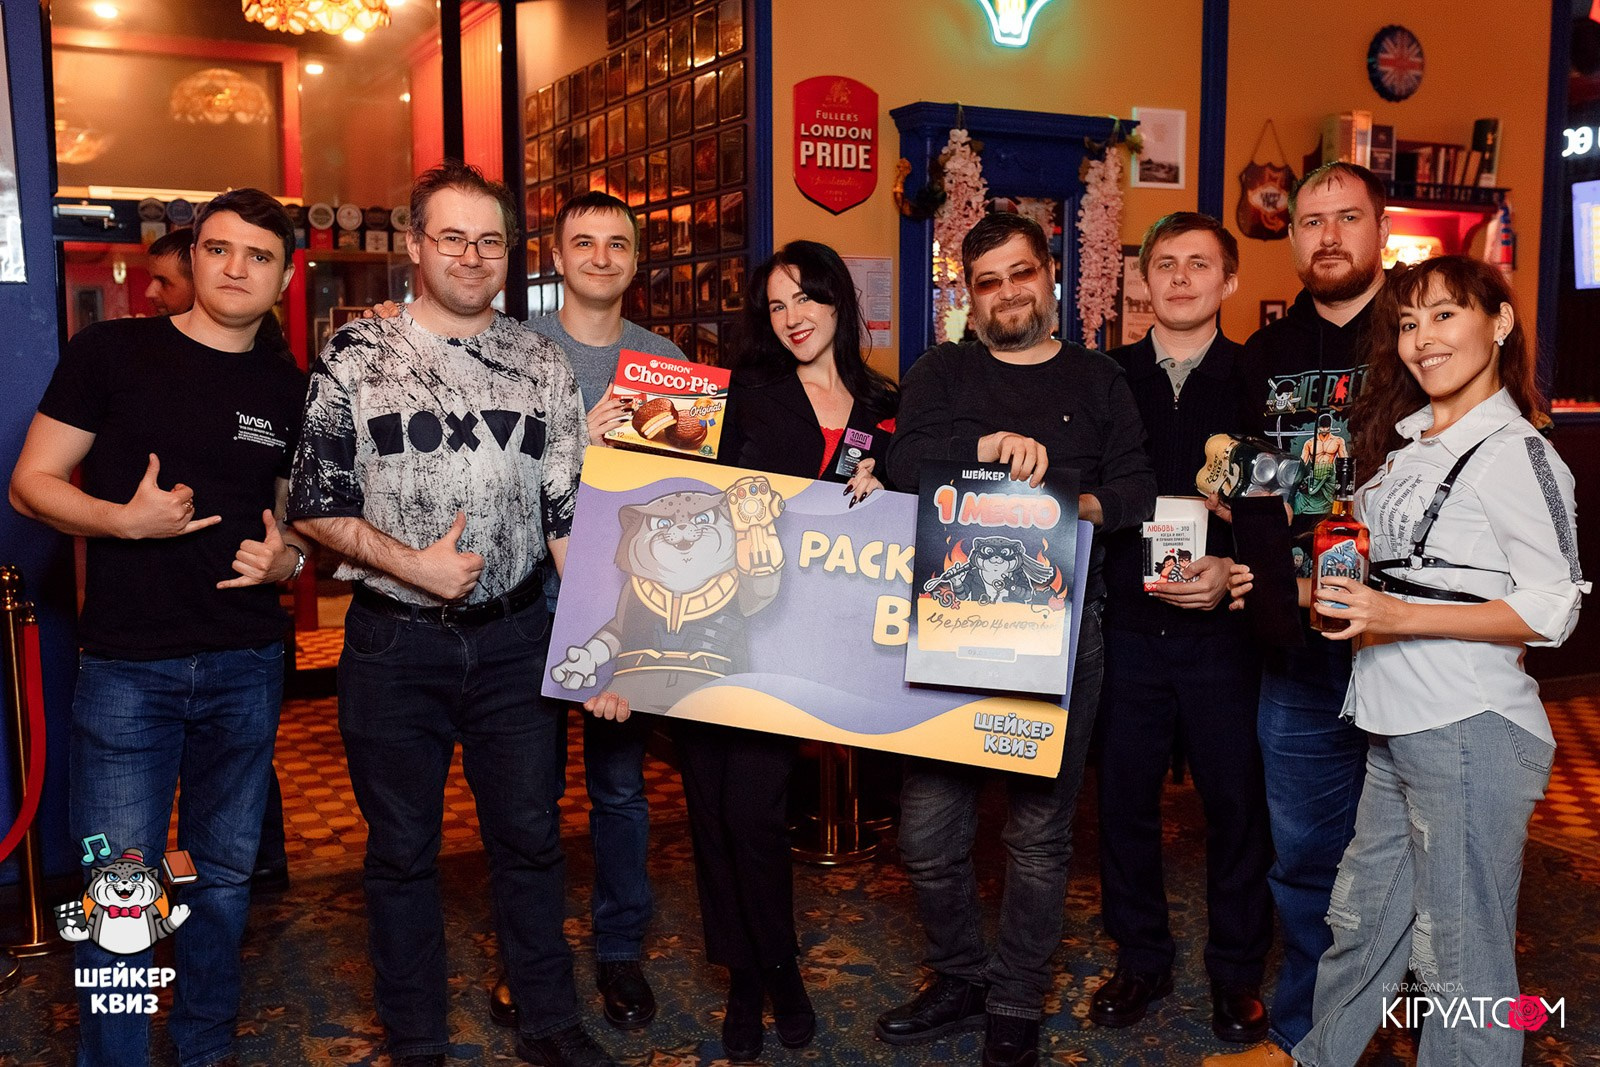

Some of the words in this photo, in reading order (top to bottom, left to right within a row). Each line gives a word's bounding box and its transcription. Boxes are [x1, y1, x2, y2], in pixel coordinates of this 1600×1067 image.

[800, 123, 872, 140] LONDON
[800, 141, 872, 170] PRIDE
[660, 361, 691, 374] ORION
[689, 402, 722, 417] Original
[239, 414, 272, 431] NASA
[962, 468, 1005, 481] ШЕЙКЕР
[934, 485, 957, 524] 1
[958, 491, 1061, 530] МЕСТО
[974, 712, 1054, 741] ШЕЙКЕР
[984, 734, 1038, 759] КВИЗ
